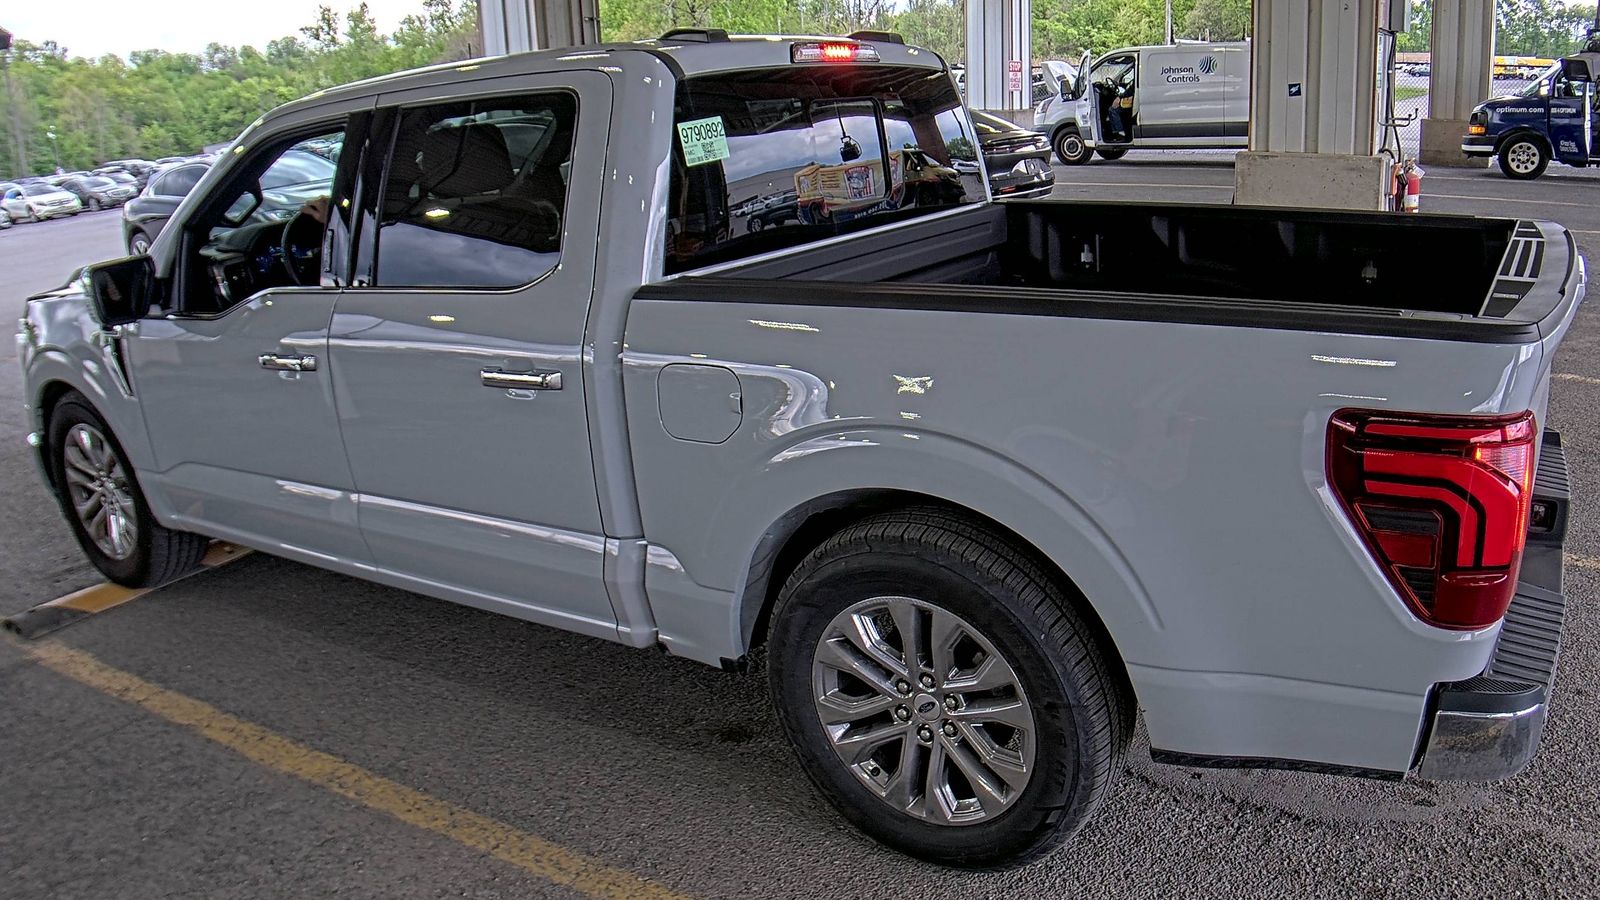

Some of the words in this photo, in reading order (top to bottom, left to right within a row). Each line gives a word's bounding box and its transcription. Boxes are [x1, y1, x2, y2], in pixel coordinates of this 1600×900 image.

[1009, 62, 1021, 71] STOP
[1160, 65, 1194, 75] Johnson
[1166, 74, 1200, 83] Controls
[1495, 106, 1544, 114] optimum.com
[681, 121, 725, 144] 9790892
